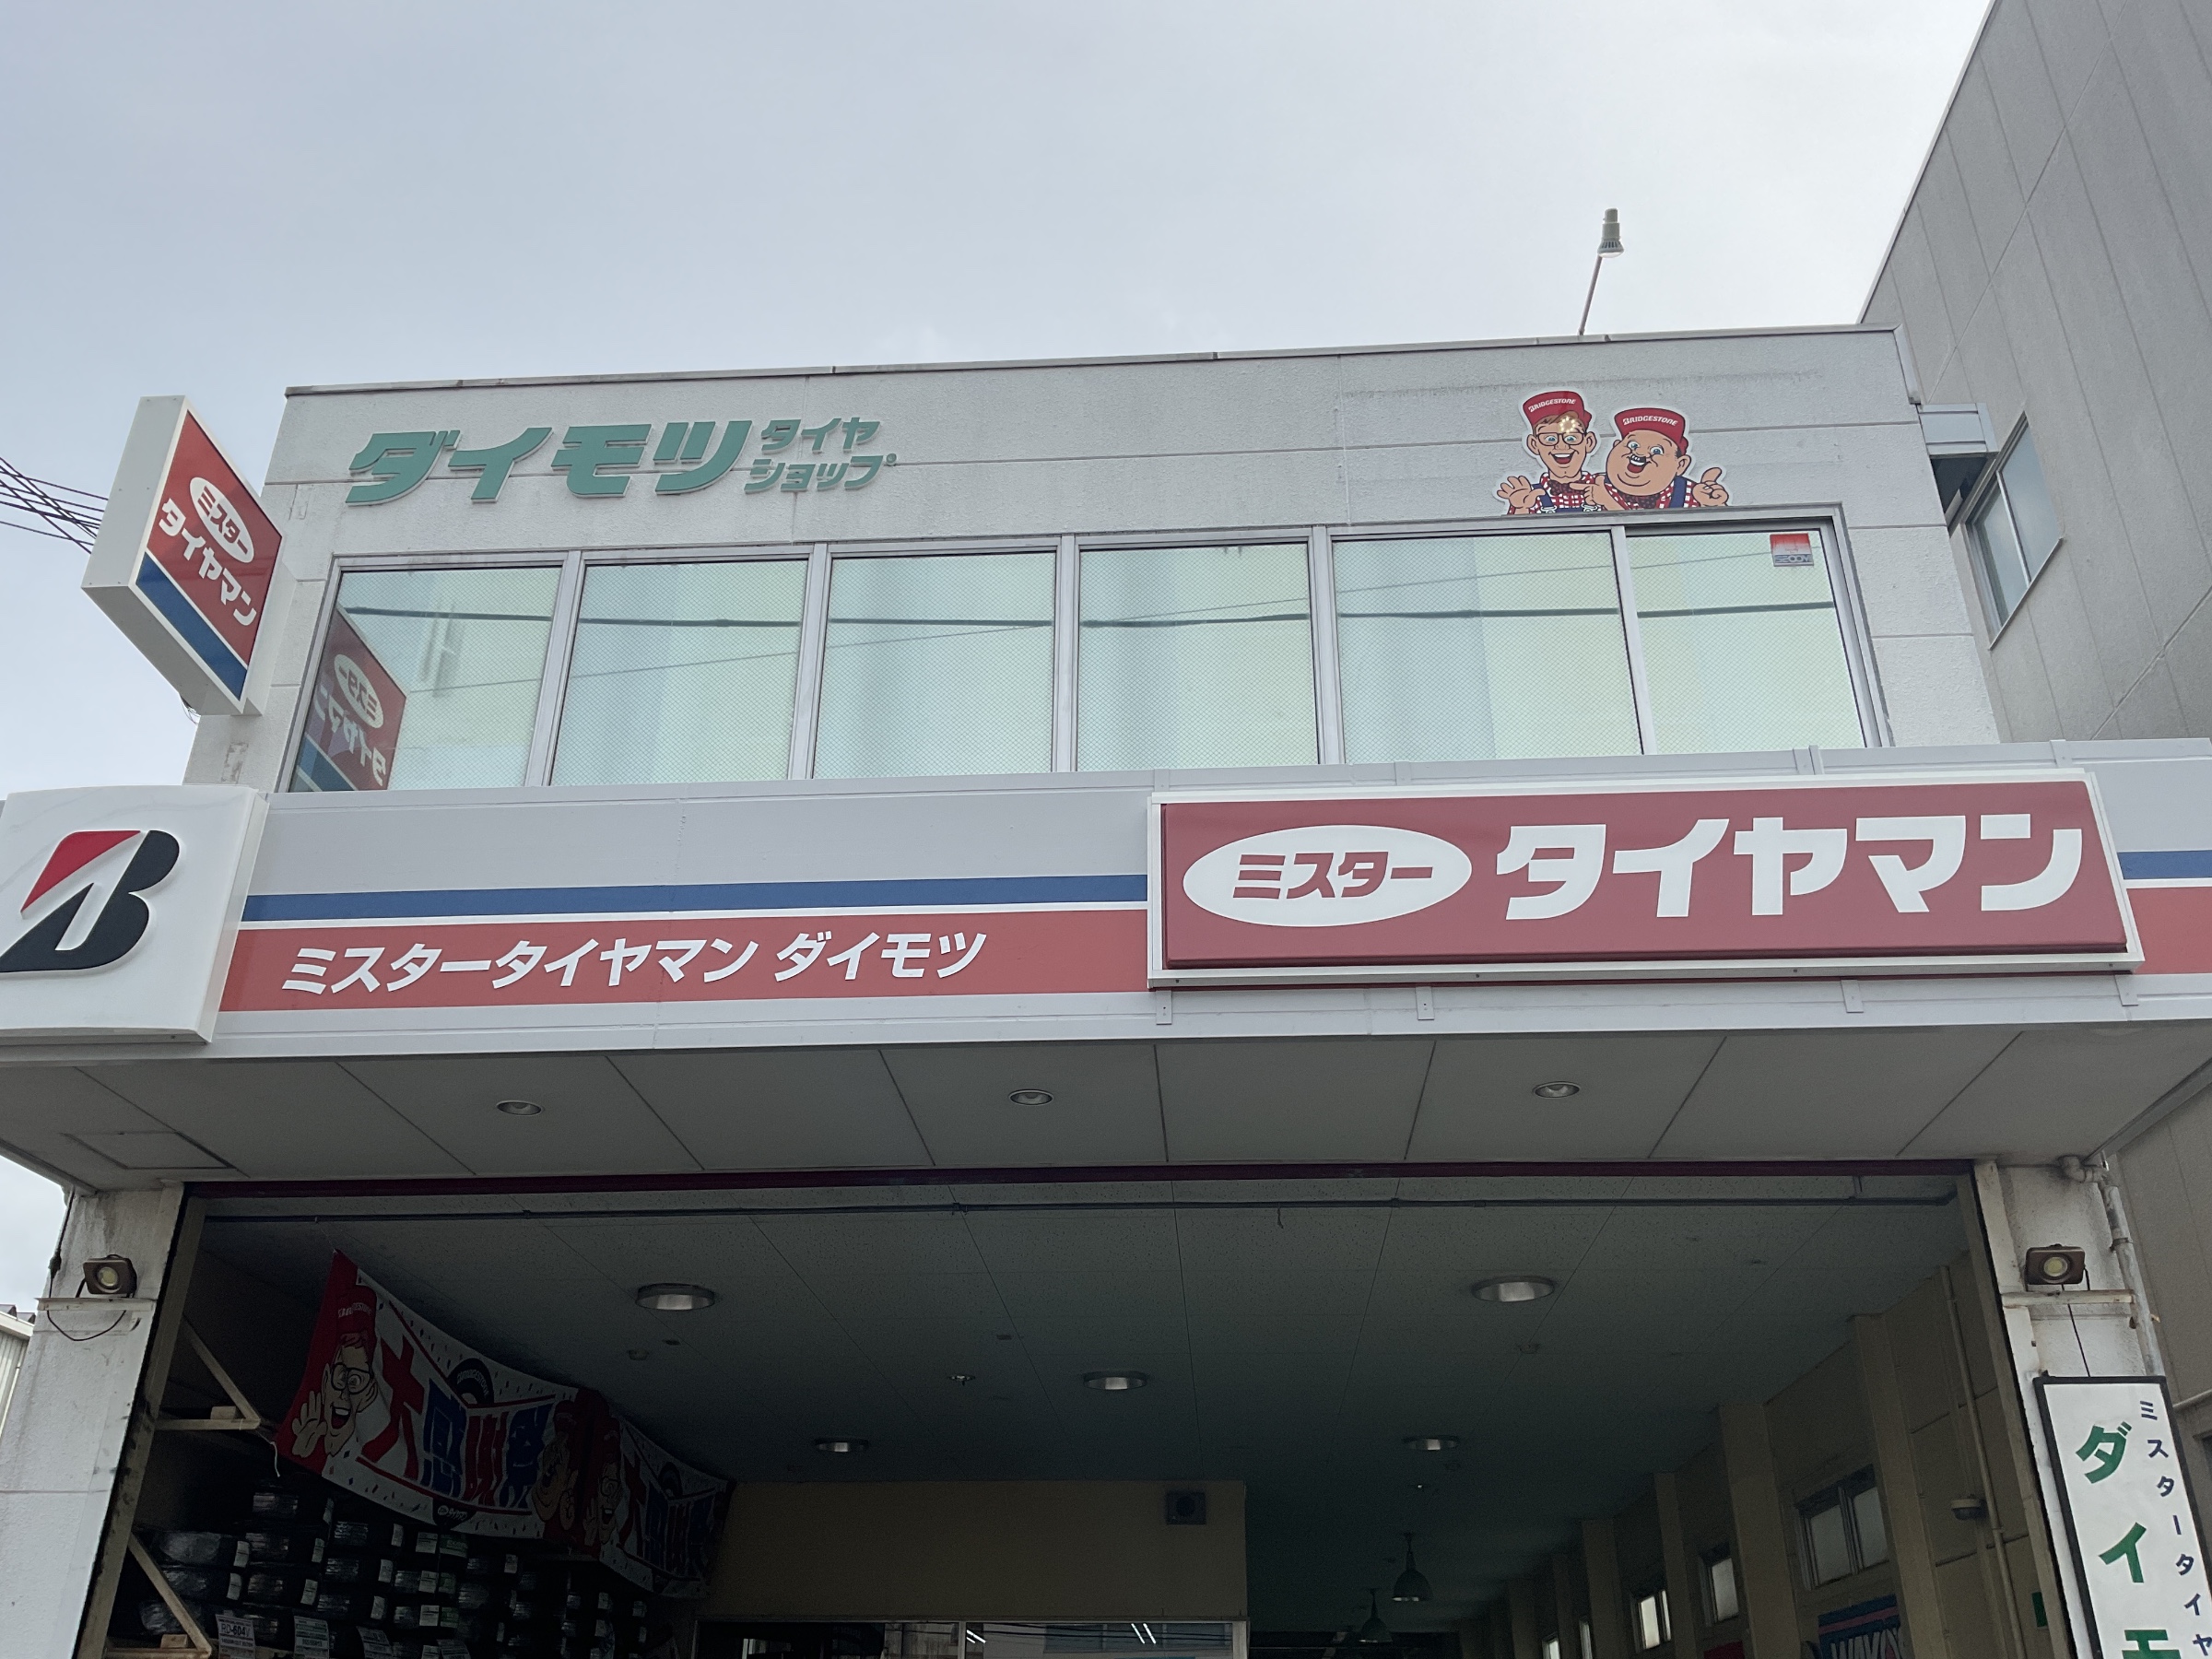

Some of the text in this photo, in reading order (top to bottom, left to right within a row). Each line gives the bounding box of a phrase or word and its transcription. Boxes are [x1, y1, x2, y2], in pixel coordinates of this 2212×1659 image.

[759, 417, 882, 454] タイヤ
[1527, 398, 1577, 413] BRIDGESTONE
[1622, 415, 1678, 427] BRIDGESTONE
[345, 420, 753, 506] ダイモツ
[743, 452, 898, 494] ショップ
[197, 486, 249, 555] ミスター
[159, 498, 257, 626] タイヤマン
[1232, 813, 2083, 921] ミスター タイヤマン
[281, 930, 988, 994] ミスタータイヤマン ダイモツ
